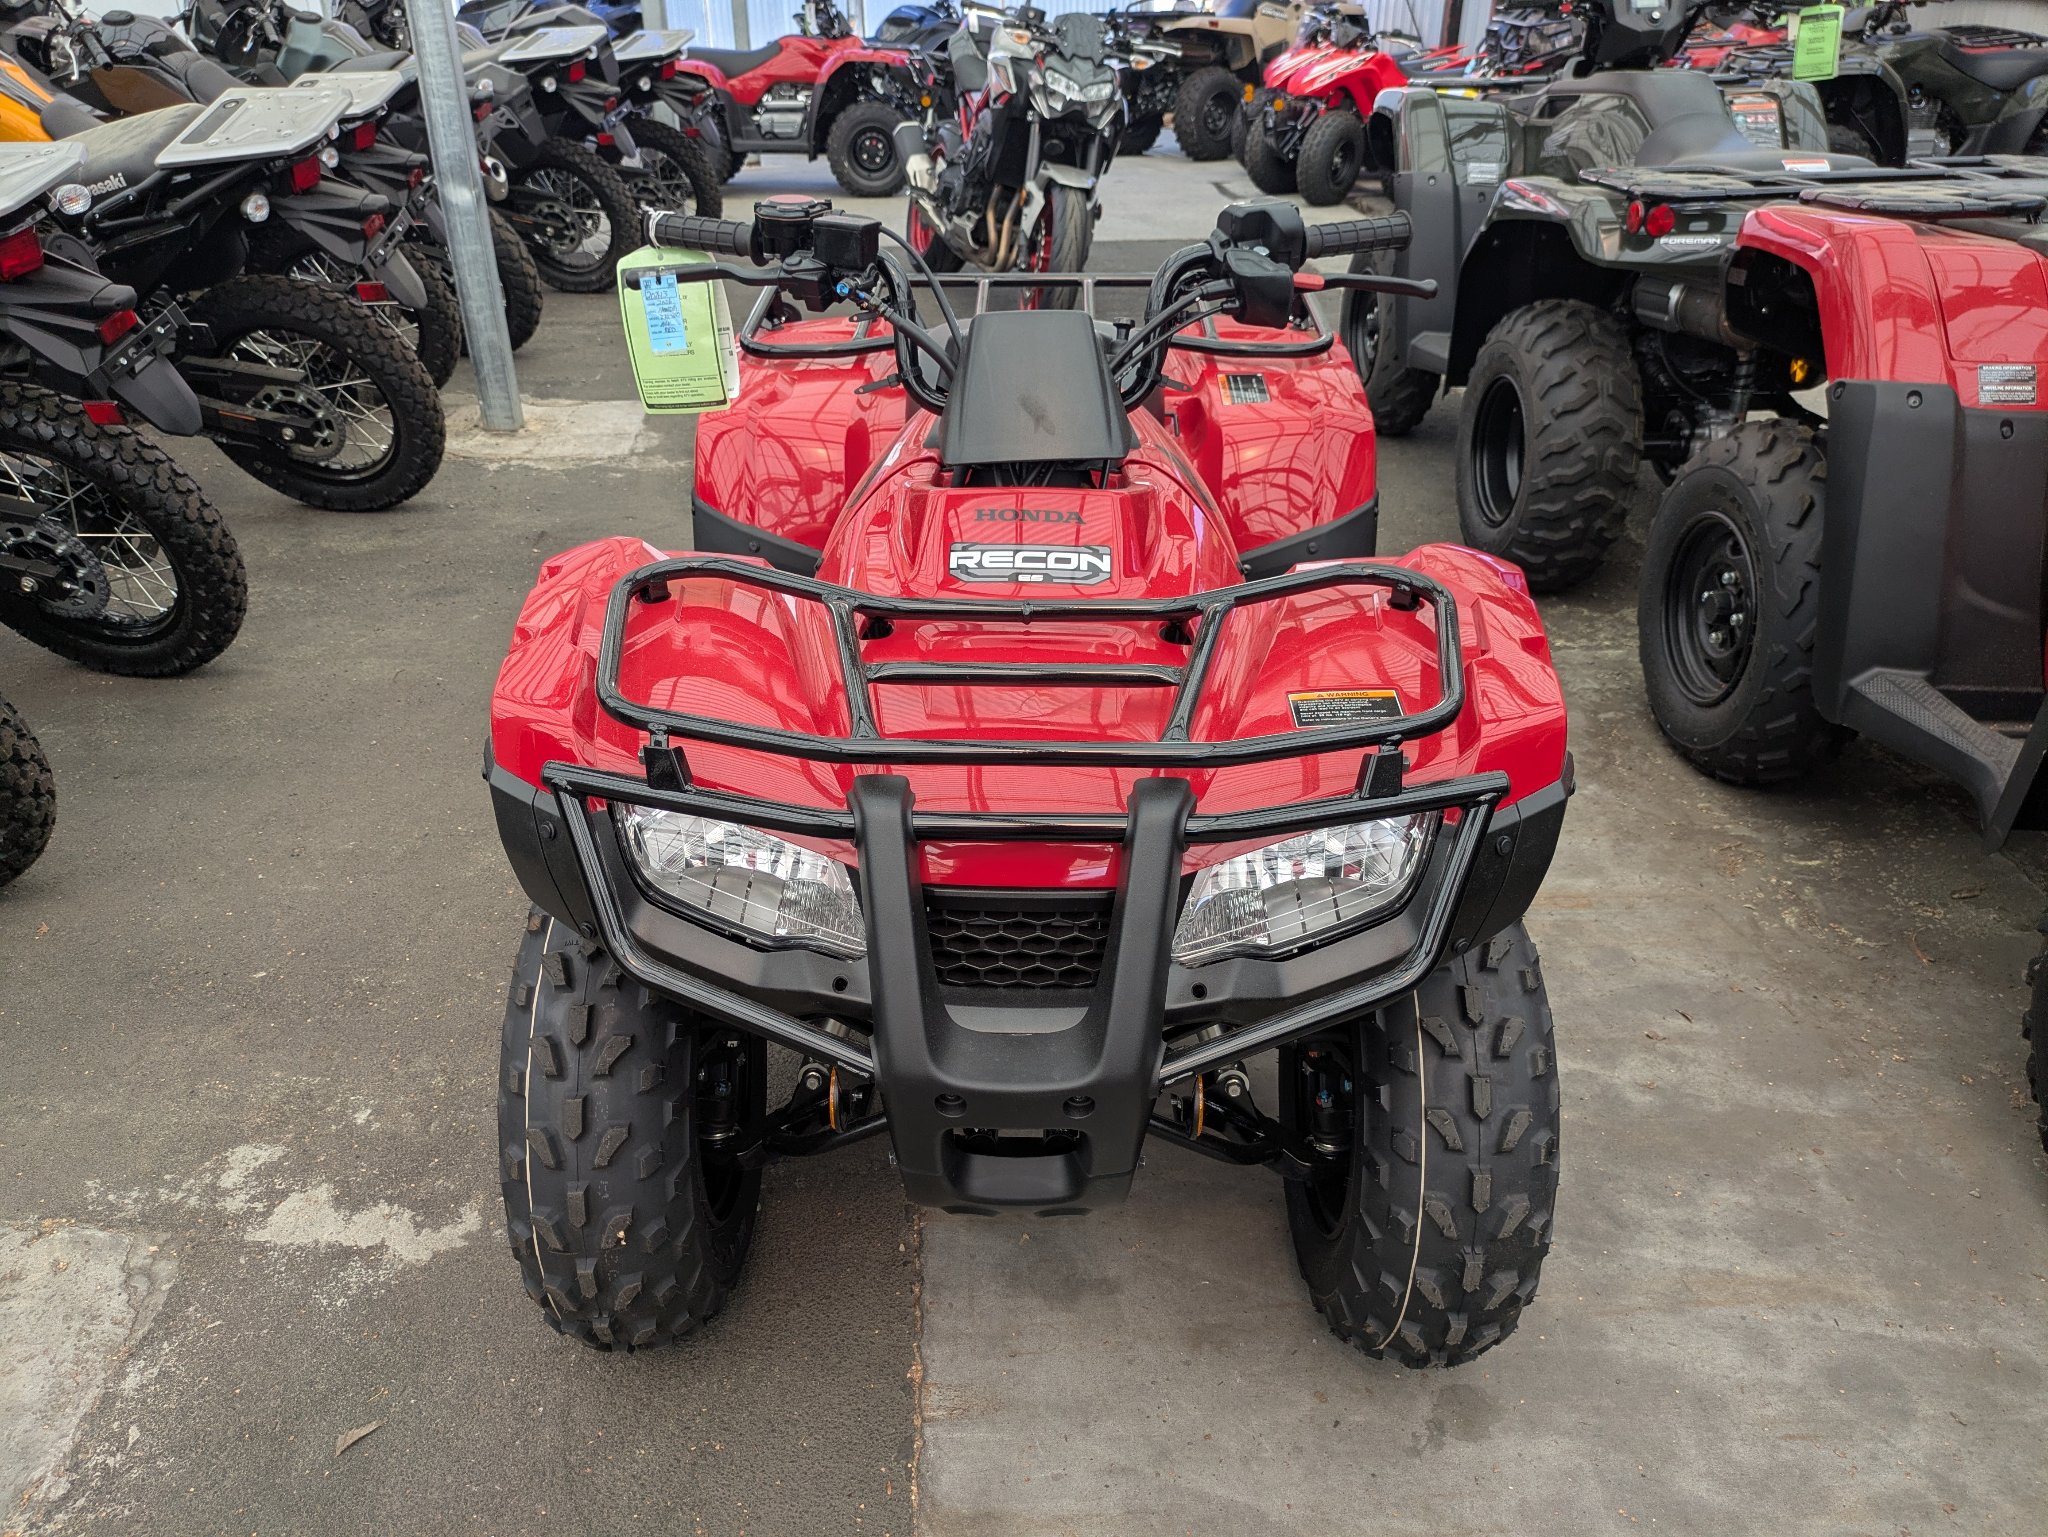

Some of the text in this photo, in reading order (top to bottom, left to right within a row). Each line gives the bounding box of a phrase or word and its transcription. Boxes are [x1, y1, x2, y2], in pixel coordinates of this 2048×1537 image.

[86, 172, 127, 196] asaki
[1660, 237, 1720, 245] FOREMAN
[975, 508, 1087, 525] HONDA
[949, 551, 1111, 572] RECON
